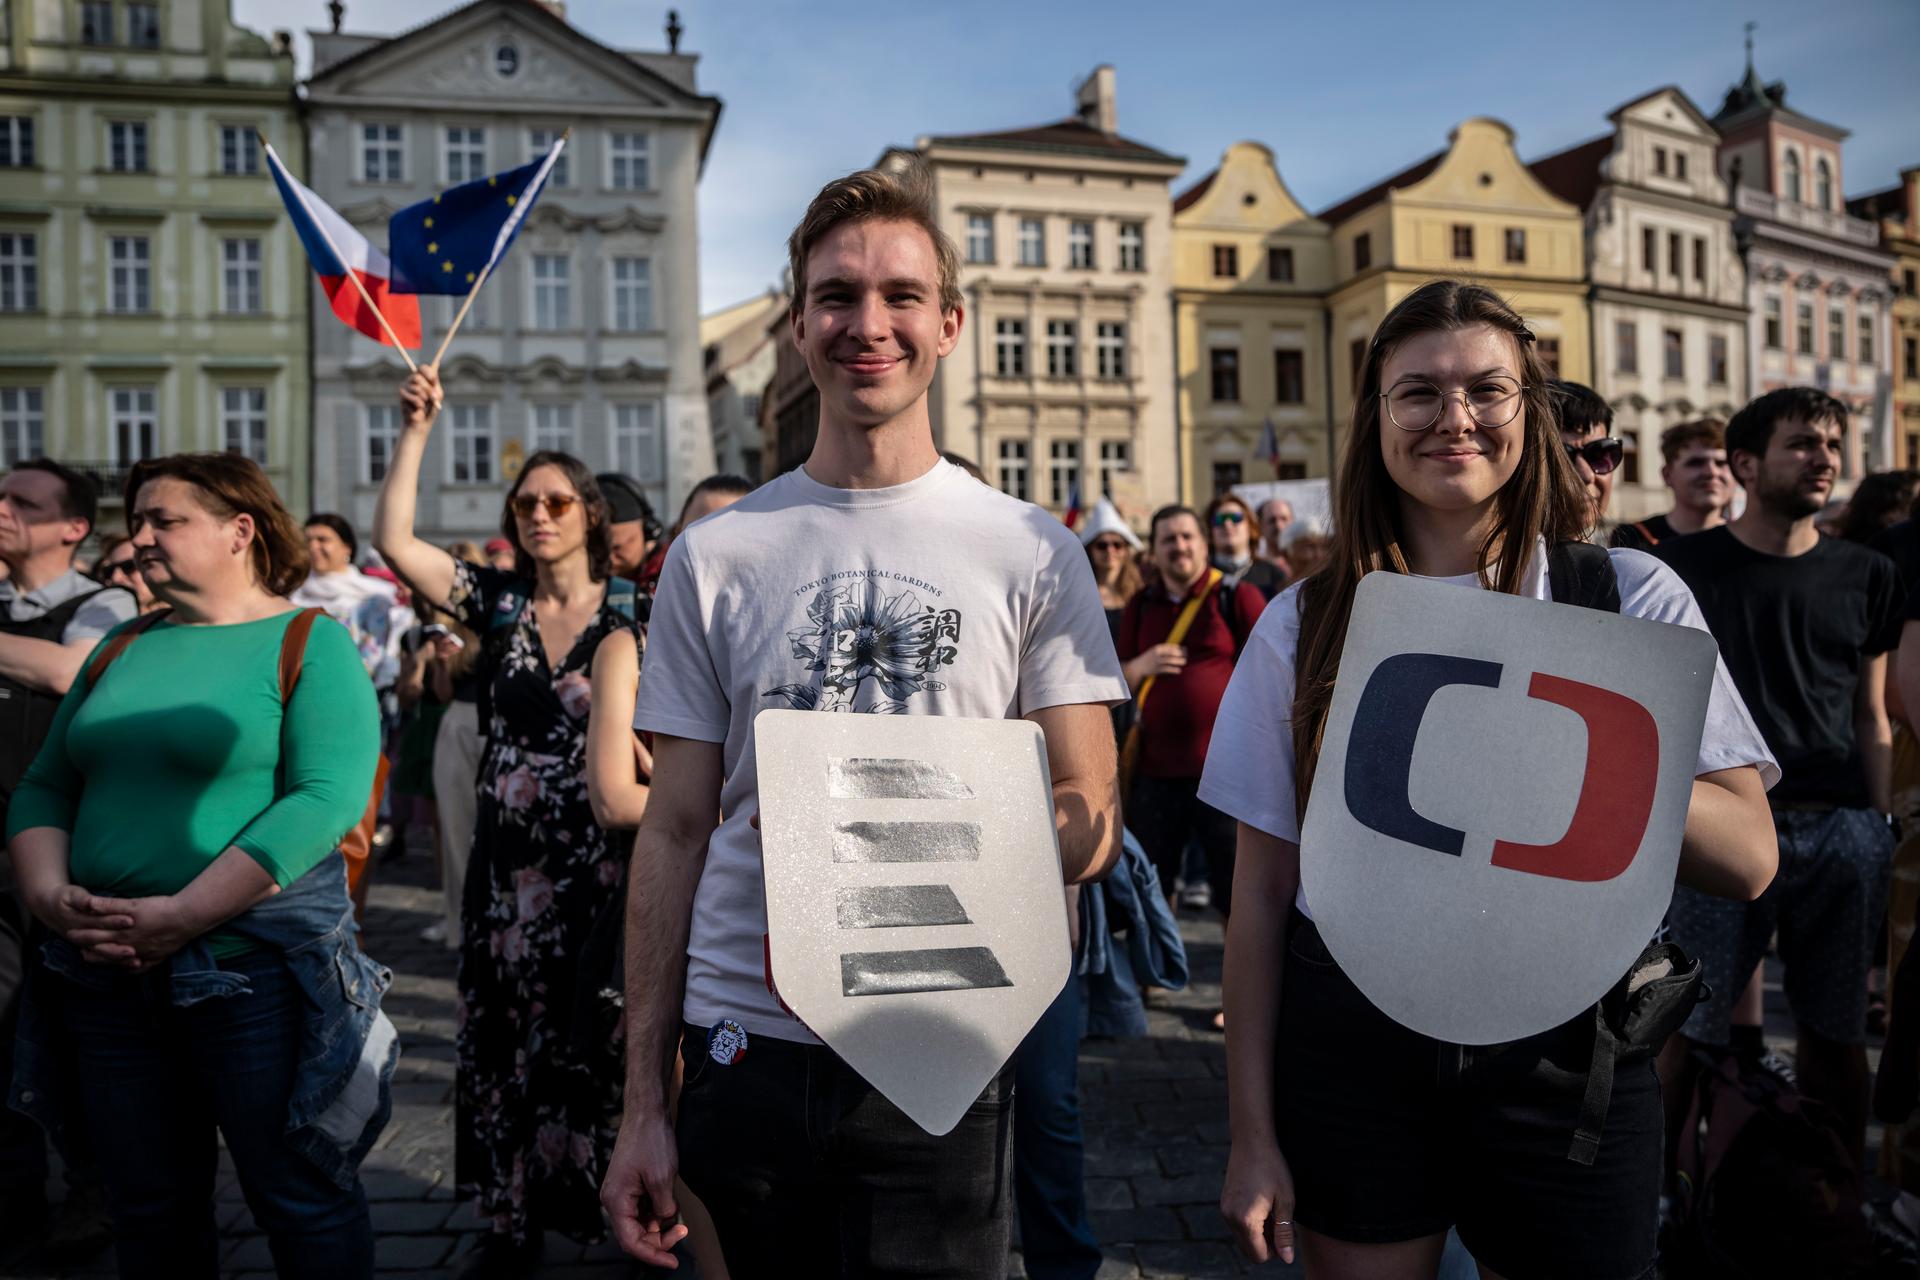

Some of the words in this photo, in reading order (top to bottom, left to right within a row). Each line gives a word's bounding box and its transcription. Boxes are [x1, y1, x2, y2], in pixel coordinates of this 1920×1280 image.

[793, 576, 829, 597] TOKYO
[831, 569, 891, 582] BOTANICAL
[893, 572, 943, 598] GARDENS
